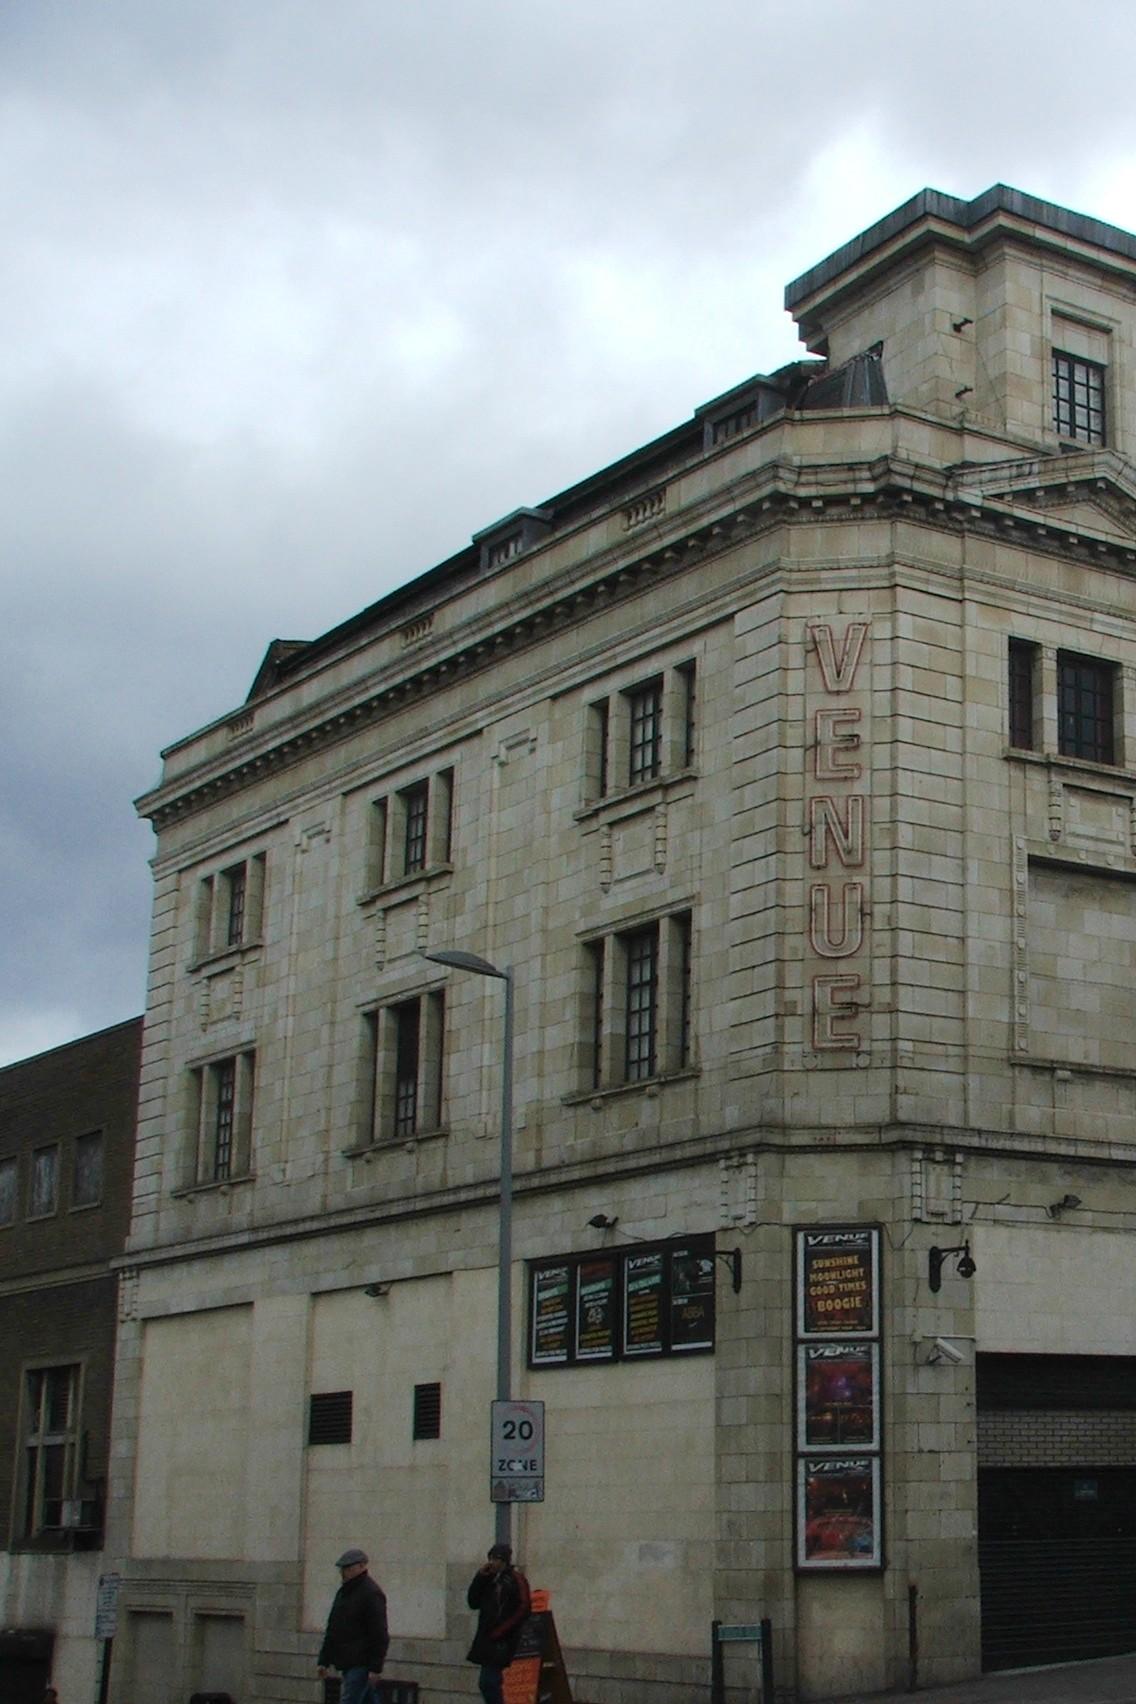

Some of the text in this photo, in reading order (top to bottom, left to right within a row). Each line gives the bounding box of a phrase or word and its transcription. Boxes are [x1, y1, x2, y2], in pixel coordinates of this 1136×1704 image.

[811, 622, 866, 1051] VENUE
[808, 1233, 868, 1246] VENUE
[812, 1256, 859, 1269] SUNSHINE
[810, 1268, 864, 1282] MOONLIGHT
[810, 1281, 866, 1296] GOOD TIMES
[817, 1297, 861, 1312] BOOGIE
[808, 1345, 868, 1359] VENUE
[503, 1420, 533, 1440] 20
[808, 1460, 868, 1473] VENUE
